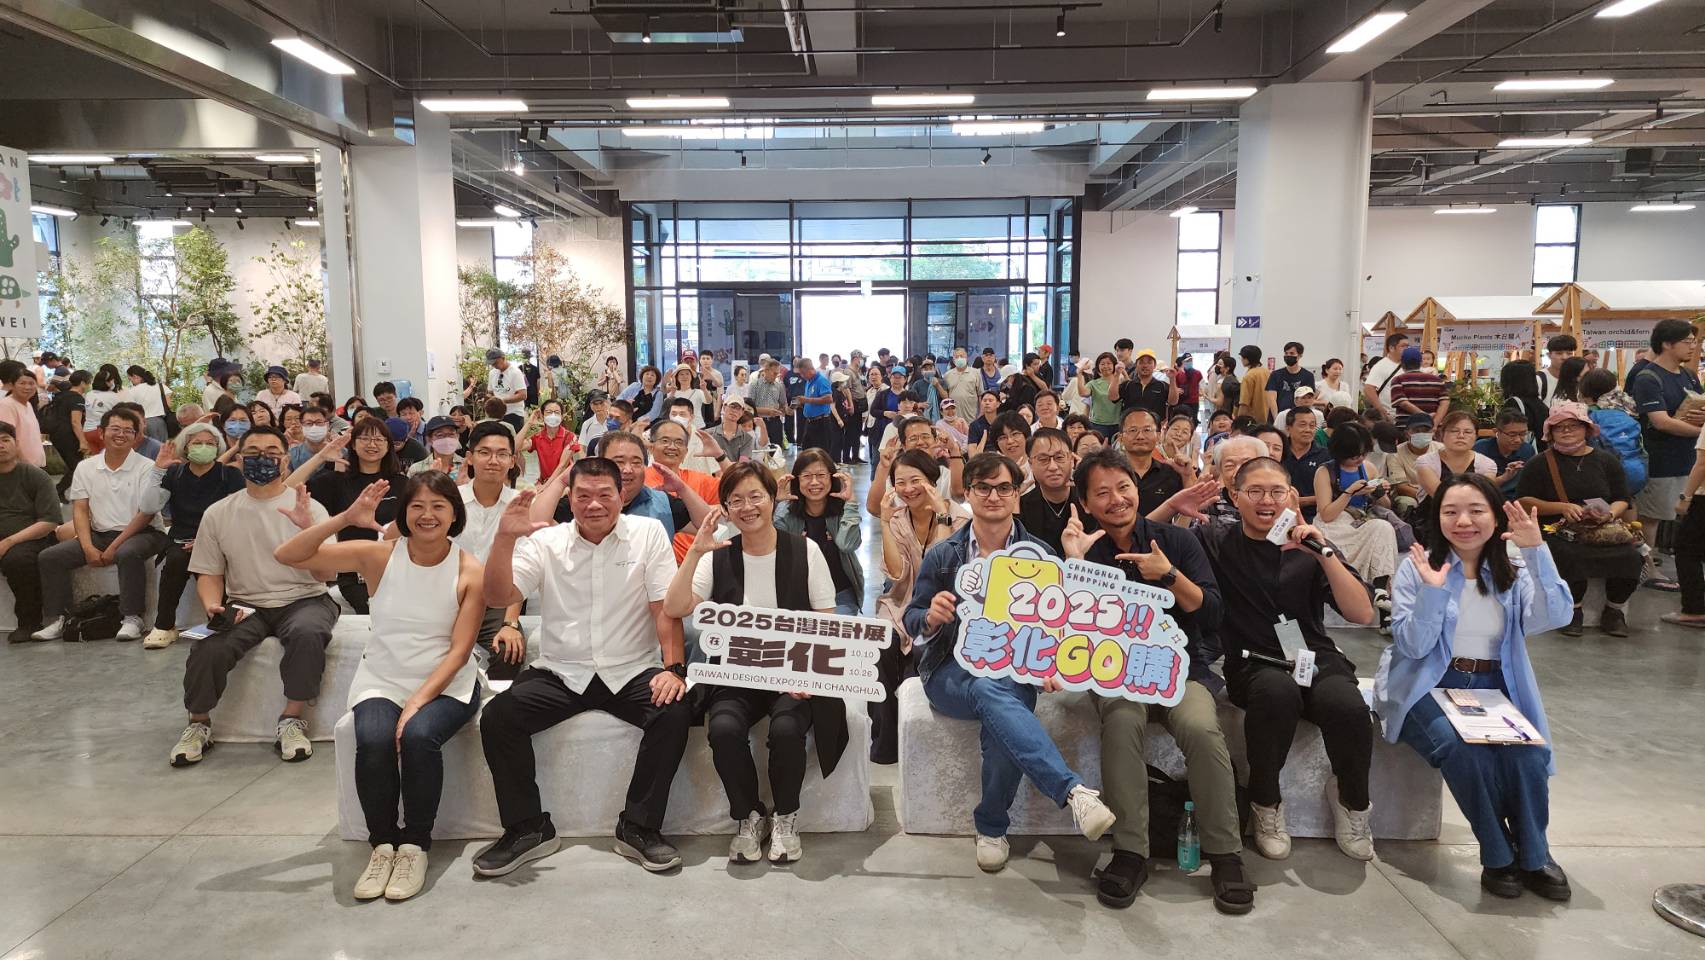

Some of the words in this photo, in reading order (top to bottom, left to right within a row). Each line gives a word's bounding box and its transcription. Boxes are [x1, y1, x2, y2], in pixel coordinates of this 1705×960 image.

[1068, 563, 1120, 581] CHANGHUA
[698, 607, 886, 642] 2025台灣設計展
[709, 636, 720, 646] 在
[726, 635, 846, 676] 彰化
[851, 649, 874, 658] 10.10
[849, 668, 873, 677] 10.26
[694, 668, 730, 680] TAIWAN
[732, 673, 767, 683] DESIGN
[770, 676, 809, 688] EXPO'25
[812, 681, 822, 689] IN
[824, 682, 880, 696] CHANGHUA
